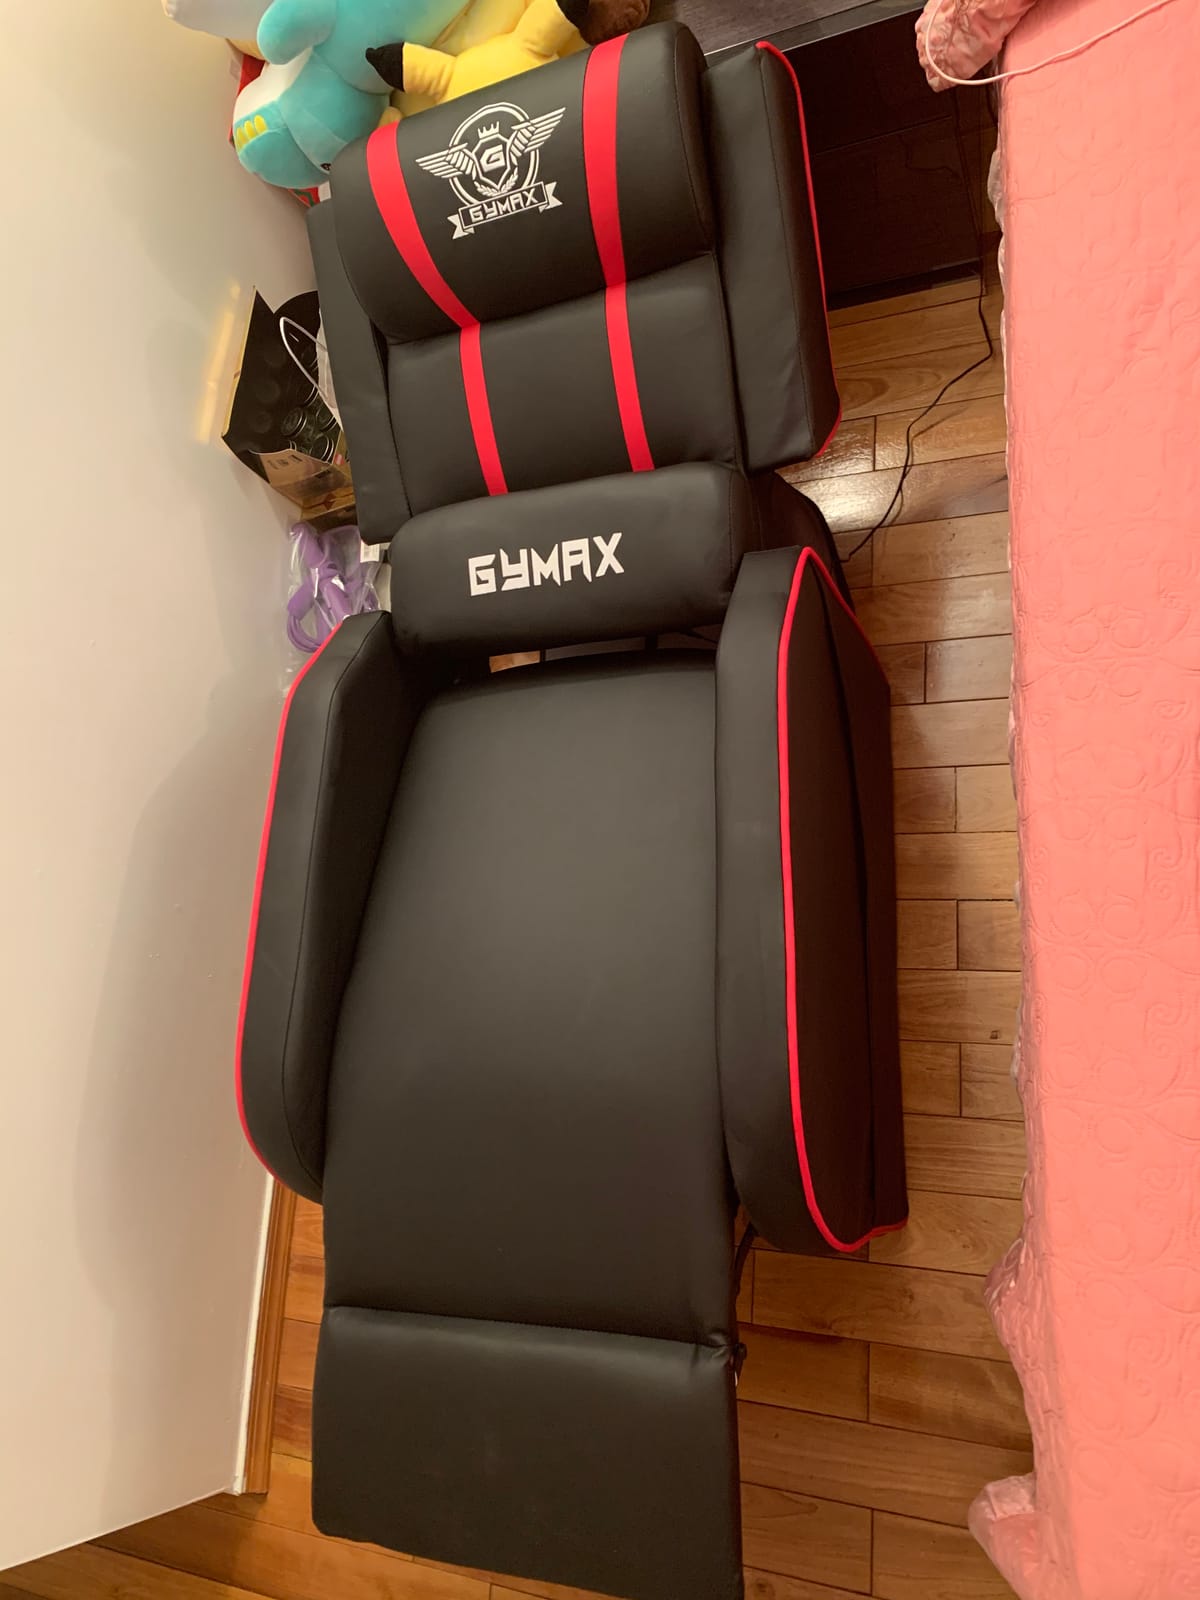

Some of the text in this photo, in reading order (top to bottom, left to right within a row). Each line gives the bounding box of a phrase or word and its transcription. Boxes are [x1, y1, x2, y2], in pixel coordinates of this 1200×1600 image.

[480, 144, 505, 172] G
[469, 188, 538, 222] GYMAX
[468, 532, 625, 596] GYMAX
